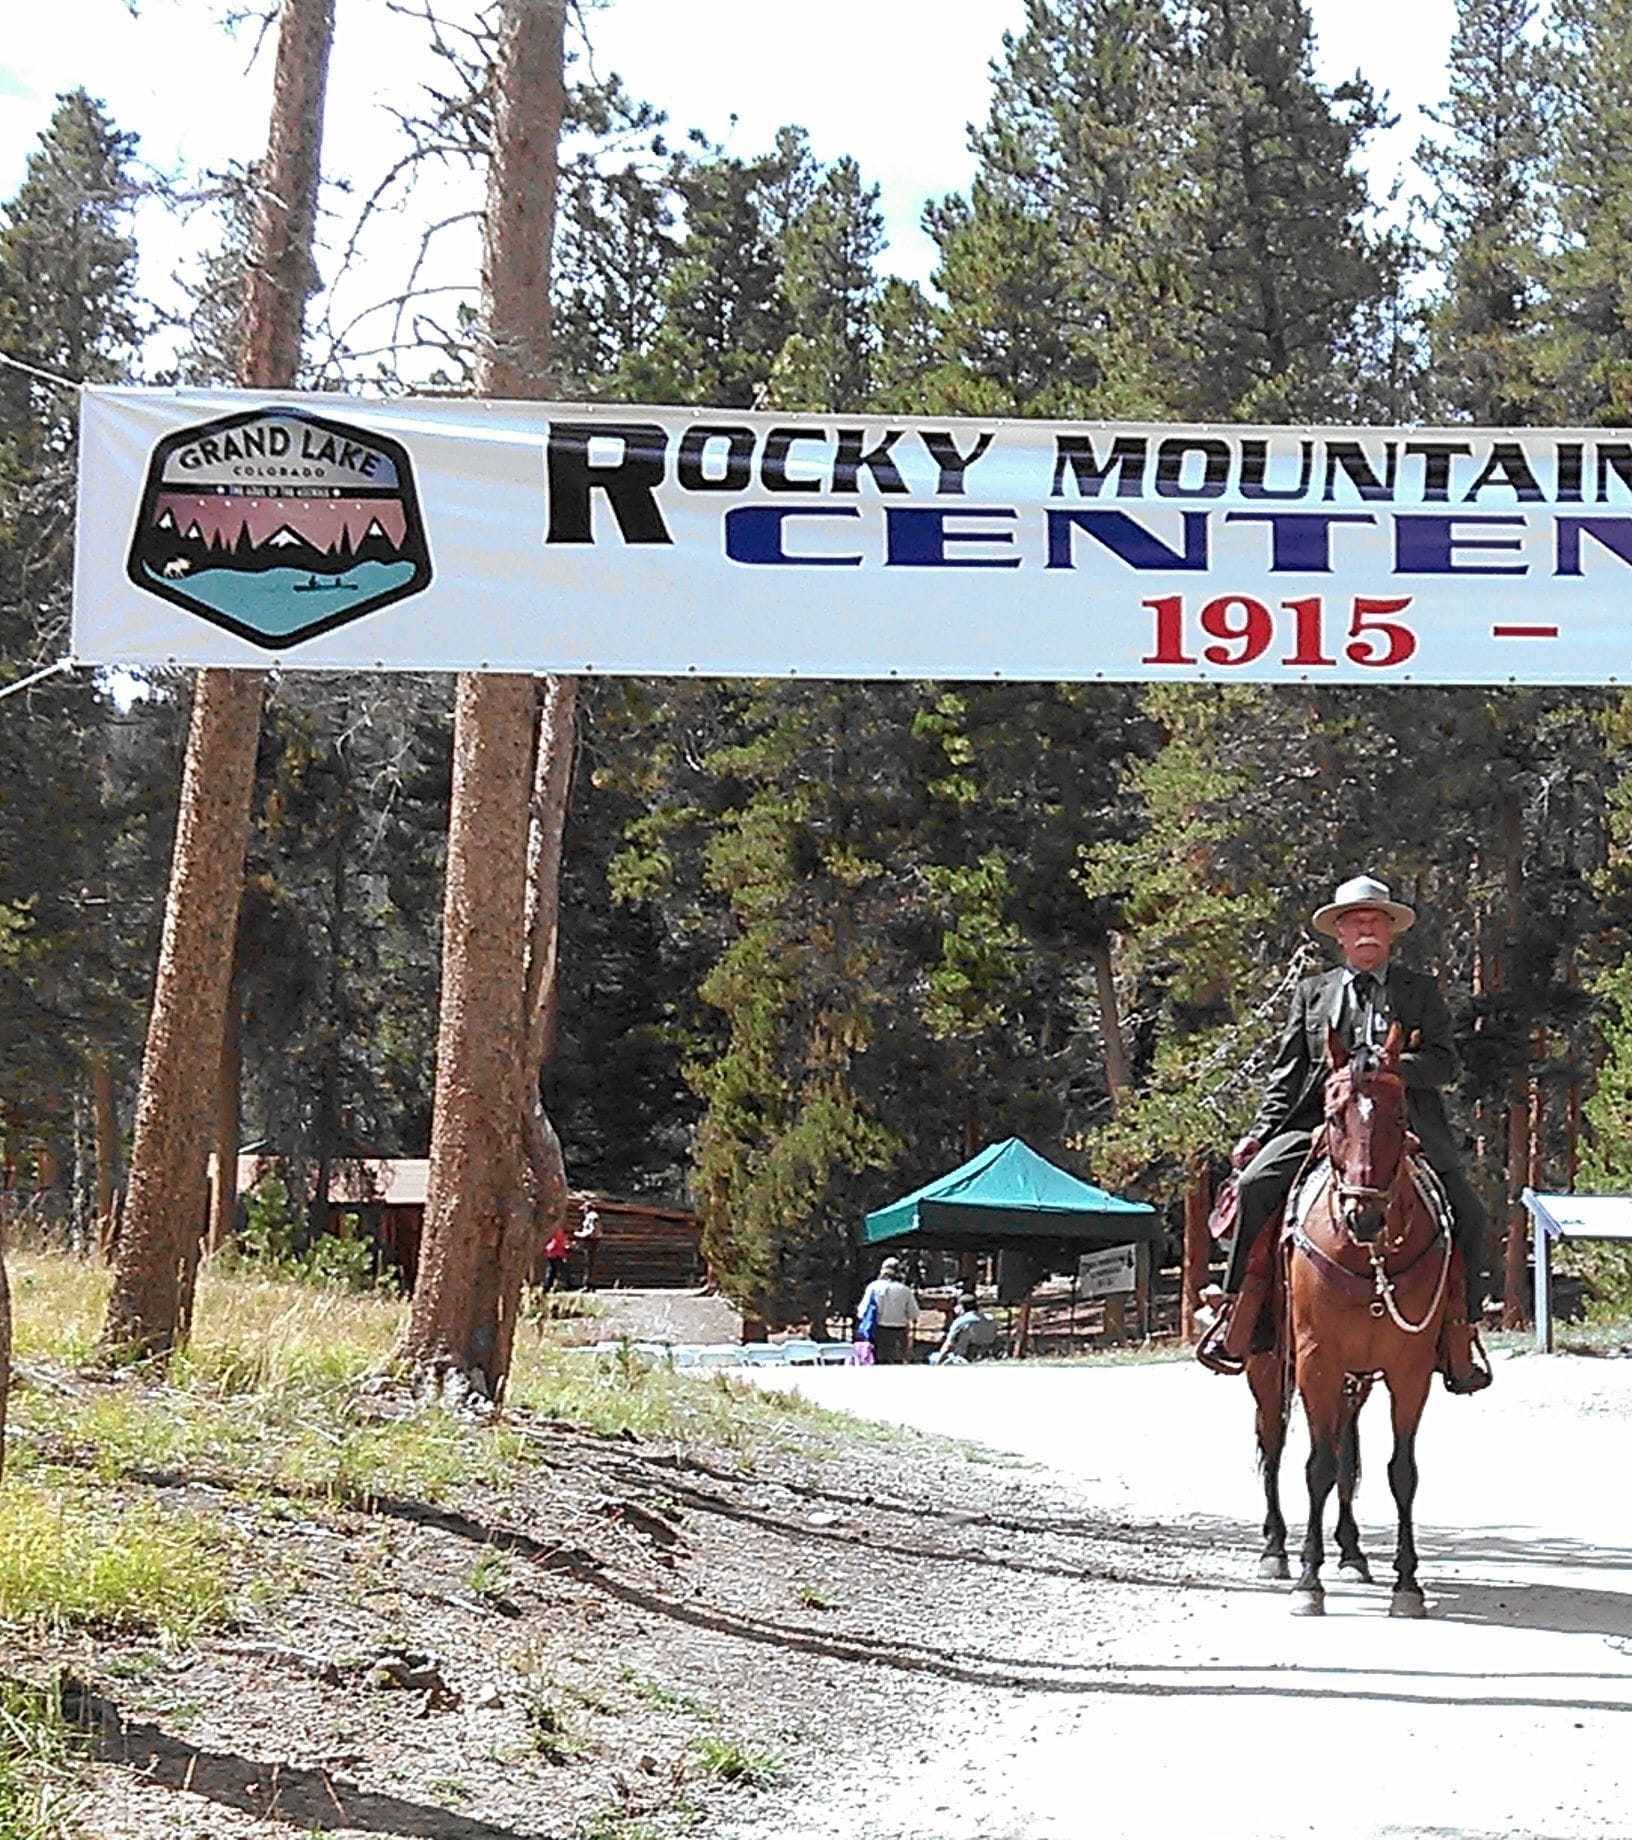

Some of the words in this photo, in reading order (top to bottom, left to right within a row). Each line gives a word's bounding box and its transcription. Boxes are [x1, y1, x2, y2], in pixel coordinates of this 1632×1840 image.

[178, 426, 291, 470] GRAND
[302, 429, 381, 478] LAKE
[232, 466, 326, 478] COLORADO
[545, 421, 996, 545] ROCKY
[1141, 595, 1417, 666] 1915
